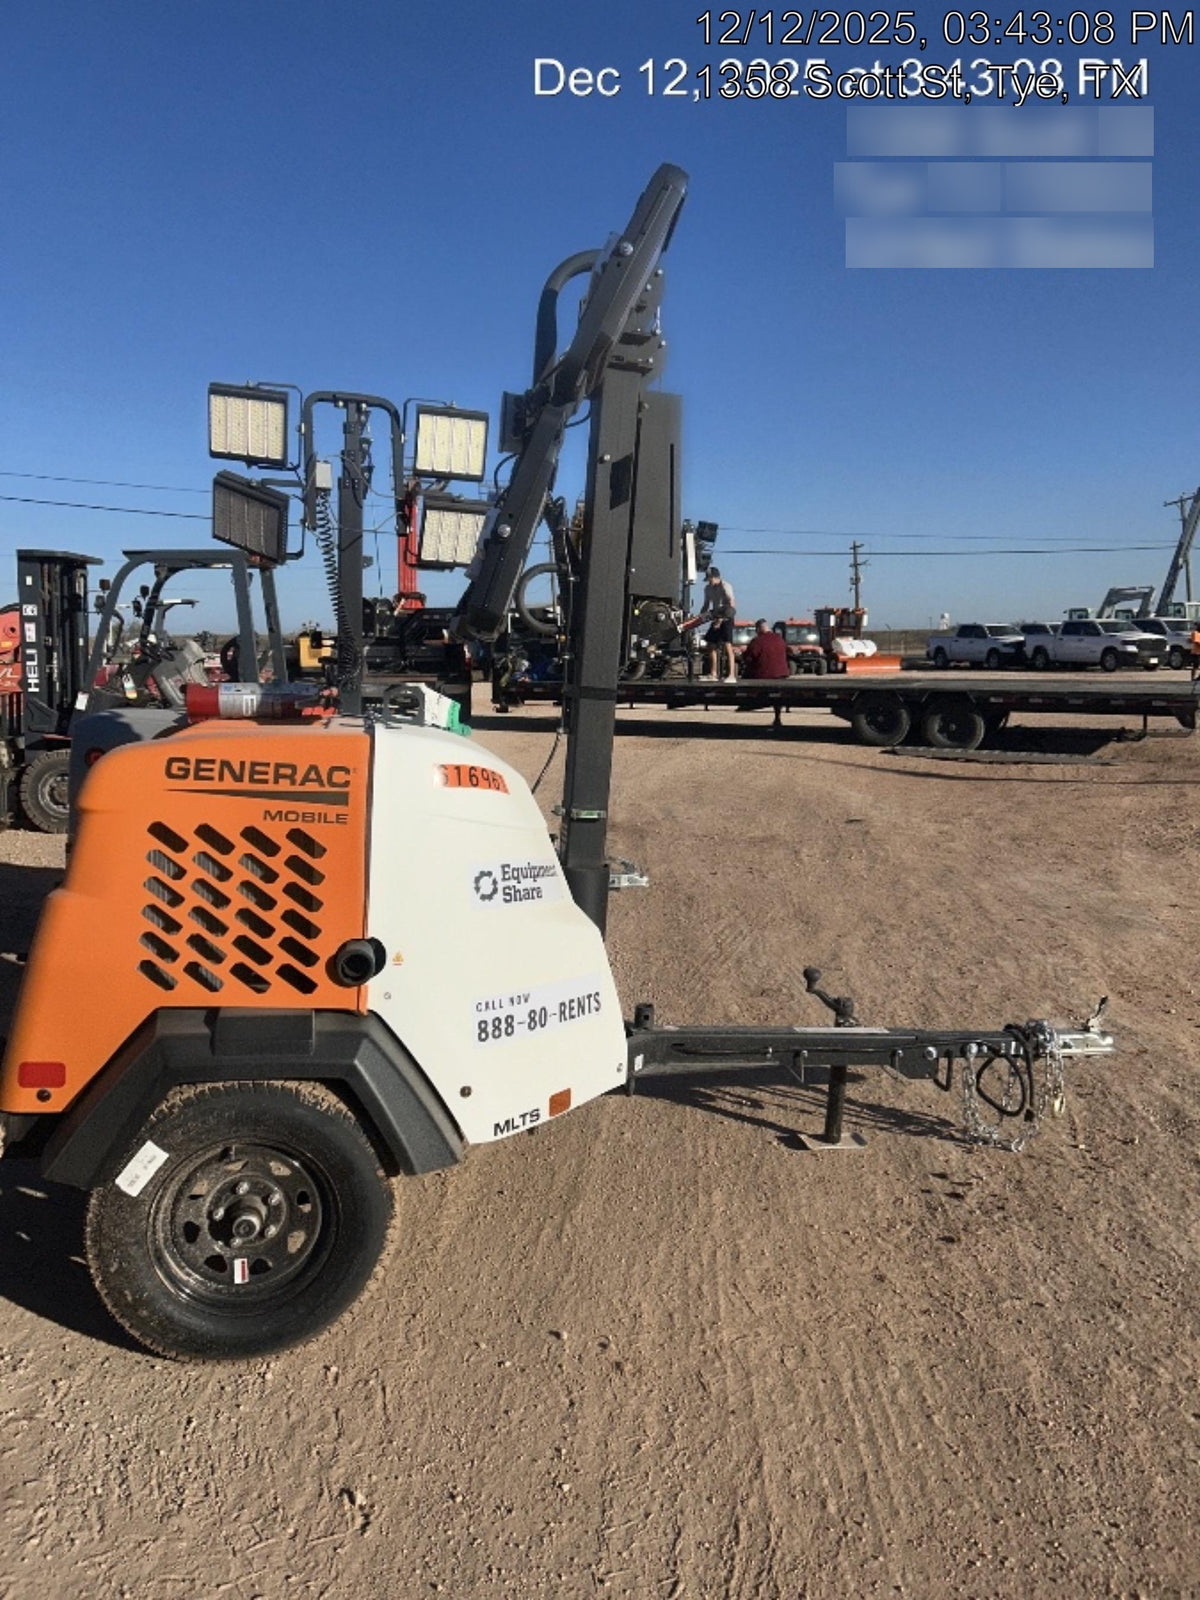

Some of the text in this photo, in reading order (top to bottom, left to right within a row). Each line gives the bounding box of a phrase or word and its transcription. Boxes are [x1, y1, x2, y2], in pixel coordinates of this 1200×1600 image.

[25, 648, 40, 693] HELI
[164, 756, 351, 788] GENERAC
[263, 809, 348, 825] MOBILE
[502, 884, 543, 903] Share
[475, 998, 504, 1013] CALL
[477, 991, 602, 1043] 888-80-RENTS
[493, 1107, 541, 1137] MLTS
